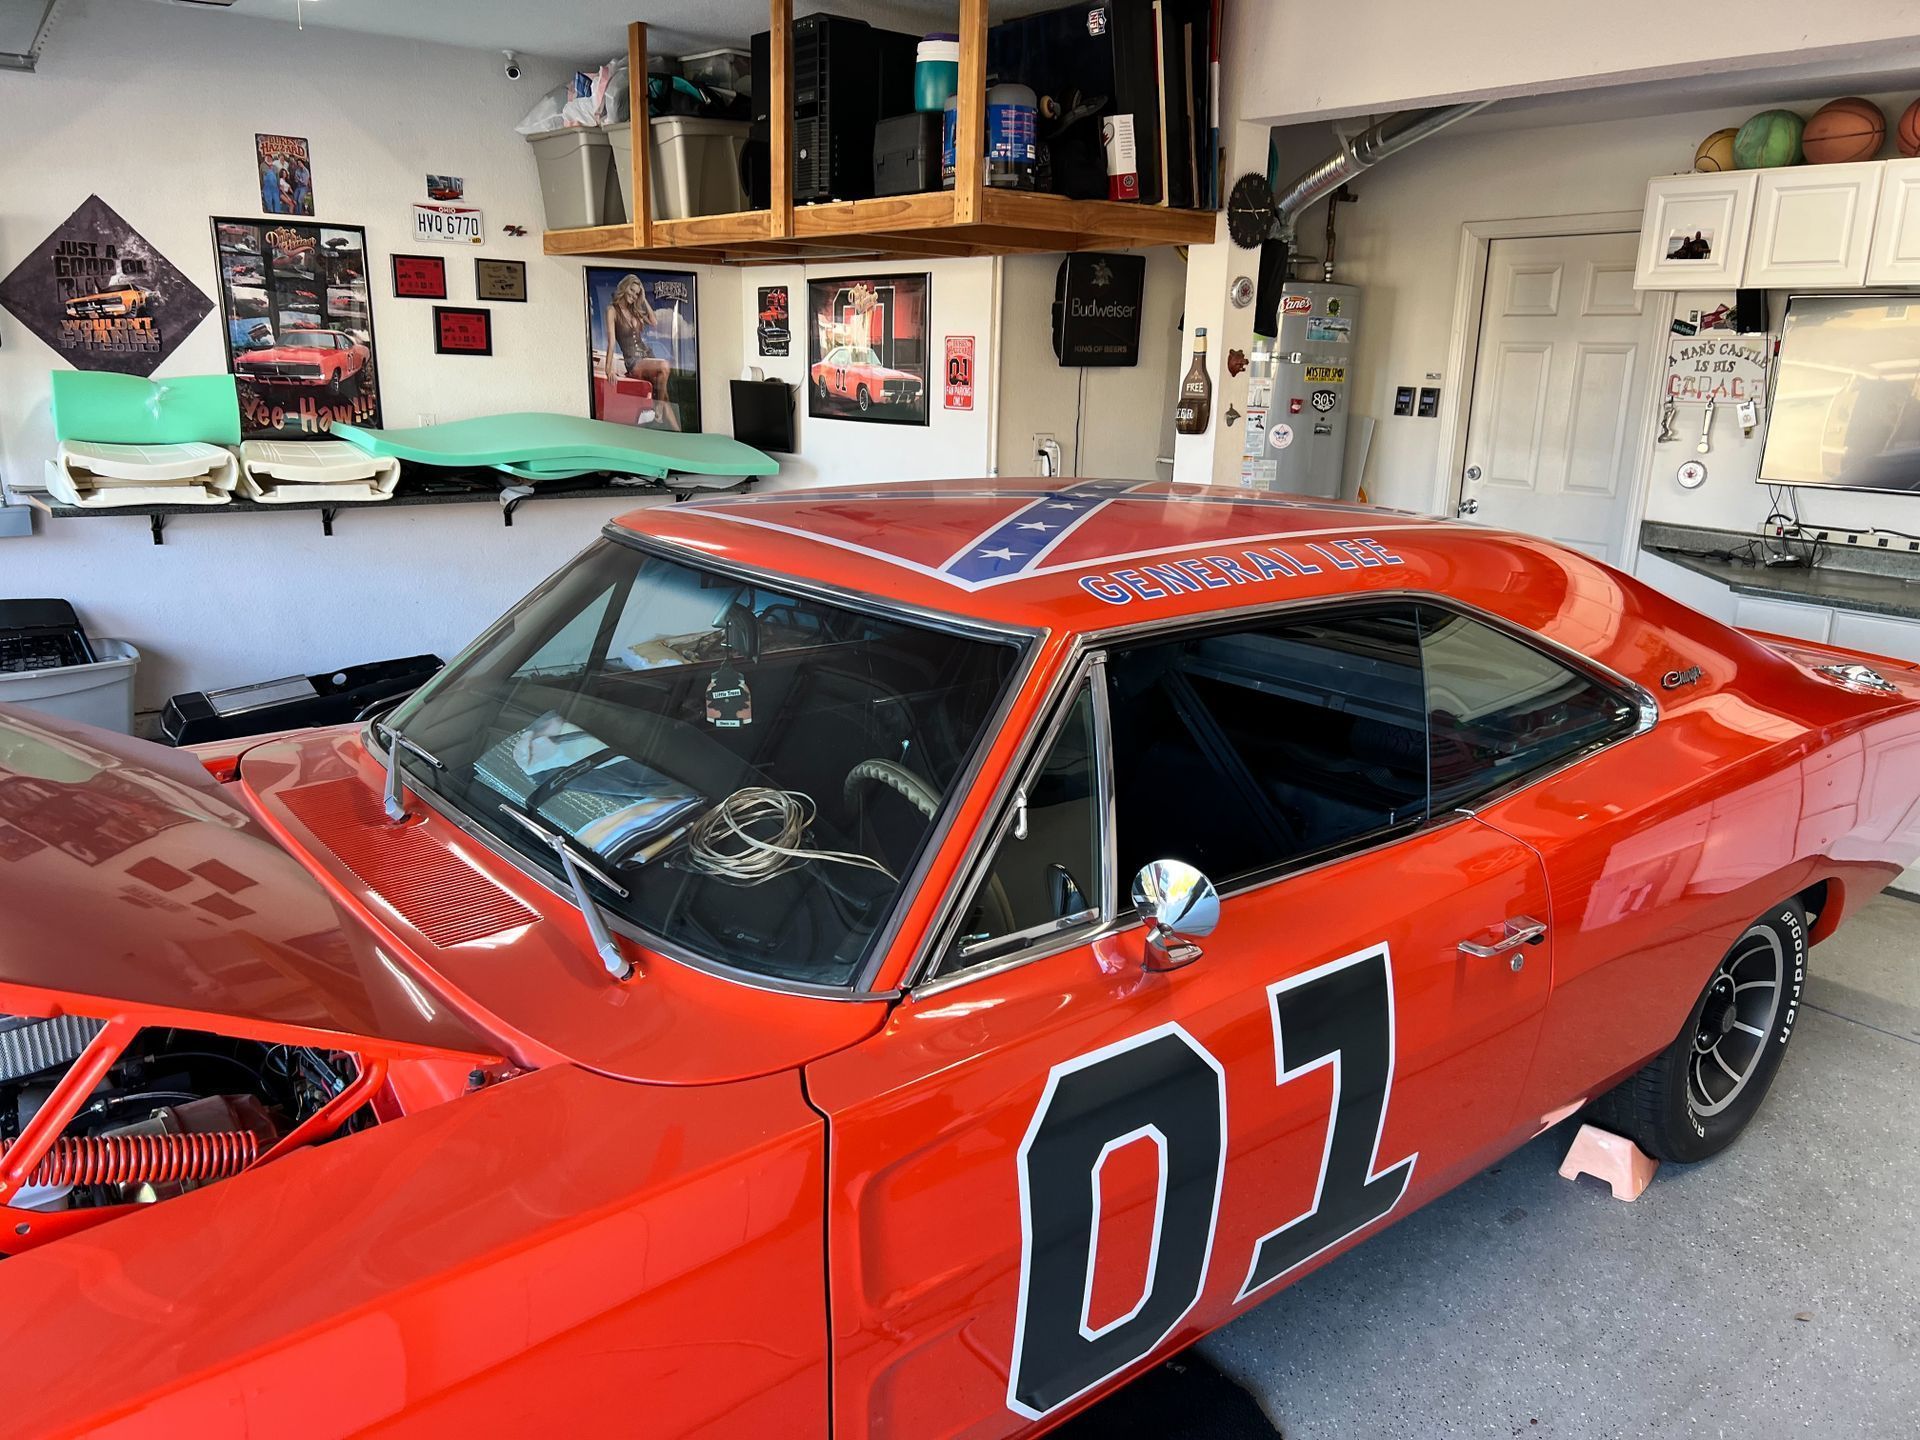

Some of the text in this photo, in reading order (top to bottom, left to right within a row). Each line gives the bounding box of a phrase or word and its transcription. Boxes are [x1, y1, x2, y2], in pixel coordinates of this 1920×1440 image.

[1089, 11, 1099, 33] NFL
[259, 142, 305, 158] HAZZARD
[418, 213, 479, 236] HVQ 6770
[56, 241, 118, 259] JUST A
[54, 257, 116, 276] GOOD
[1071, 297, 1136, 318] Budweiser
[60, 317, 154, 331] WOULDN'T
[58, 329, 161, 344] CHANGE
[99, 342, 161, 353] COULD
[1074, 344, 1127, 353] KING OF BEERS
[1668, 341, 1771, 369] A MAN'S CASTLE
[948, 358, 969, 386] 01
[1306, 366, 1331, 378] MYSTERY
[1694, 360, 1736, 373] IS HIS
[1186, 382, 1204, 393] FREE
[1312, 392, 1335, 407] 805
[1077, 538, 1405, 605] GENERAL LEE
[1780, 911, 1804, 1044] BFGoodrich
[1006, 940, 1419, 1421] 01
